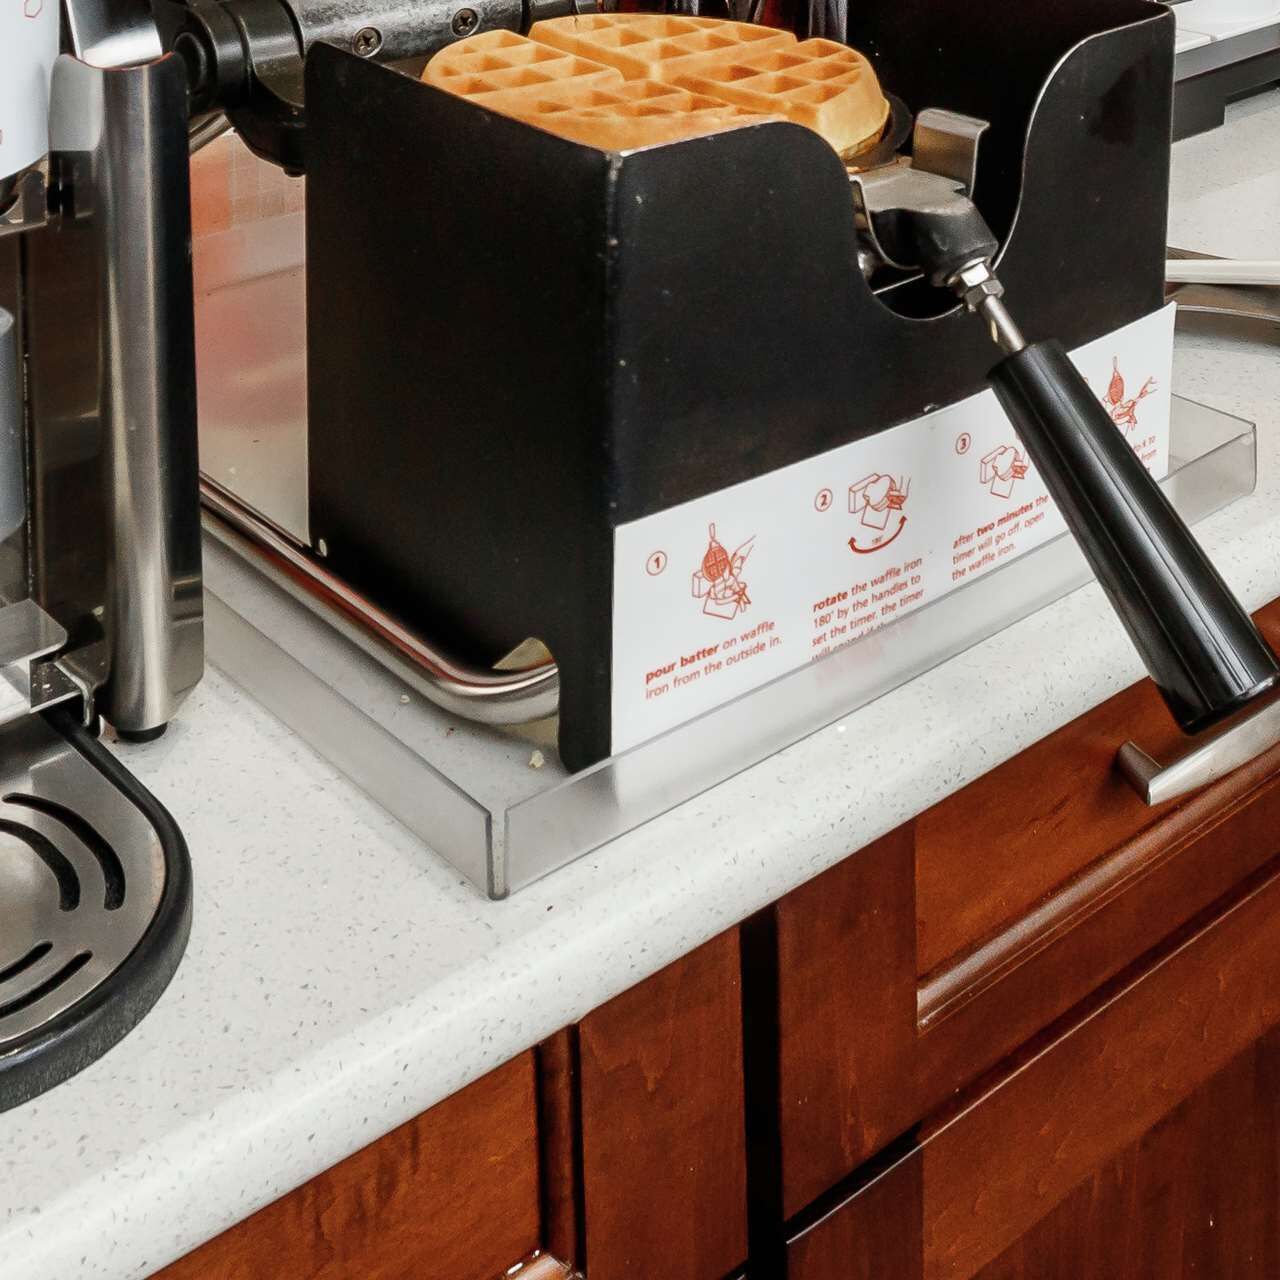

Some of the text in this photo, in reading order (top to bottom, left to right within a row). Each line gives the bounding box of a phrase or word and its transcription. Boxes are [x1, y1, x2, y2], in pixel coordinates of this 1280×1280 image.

[952, 547, 976, 565] timer
[977, 536, 993, 552] will
[995, 532, 1006, 546] go
[1024, 512, 1045, 528] open
[953, 532, 975, 549] after
[976, 522, 995, 536] two
[997, 503, 1033, 527] minutes
[813, 558, 922, 613] rotate the waffle iron
[952, 567, 967, 581] the
[968, 552, 995, 572] waffle
[812, 632, 827, 647] set
[830, 624, 847, 638] the
[881, 602, 897, 616] the
[900, 589, 924, 607] timer
[837, 607, 849, 620] by
[852, 598, 868, 612] the
[871, 581, 908, 603] handles
[911, 575, 921, 585] to
[645, 621, 775, 685] pour batter on waffle
[645, 636, 782, 700] iron from the outside in.
